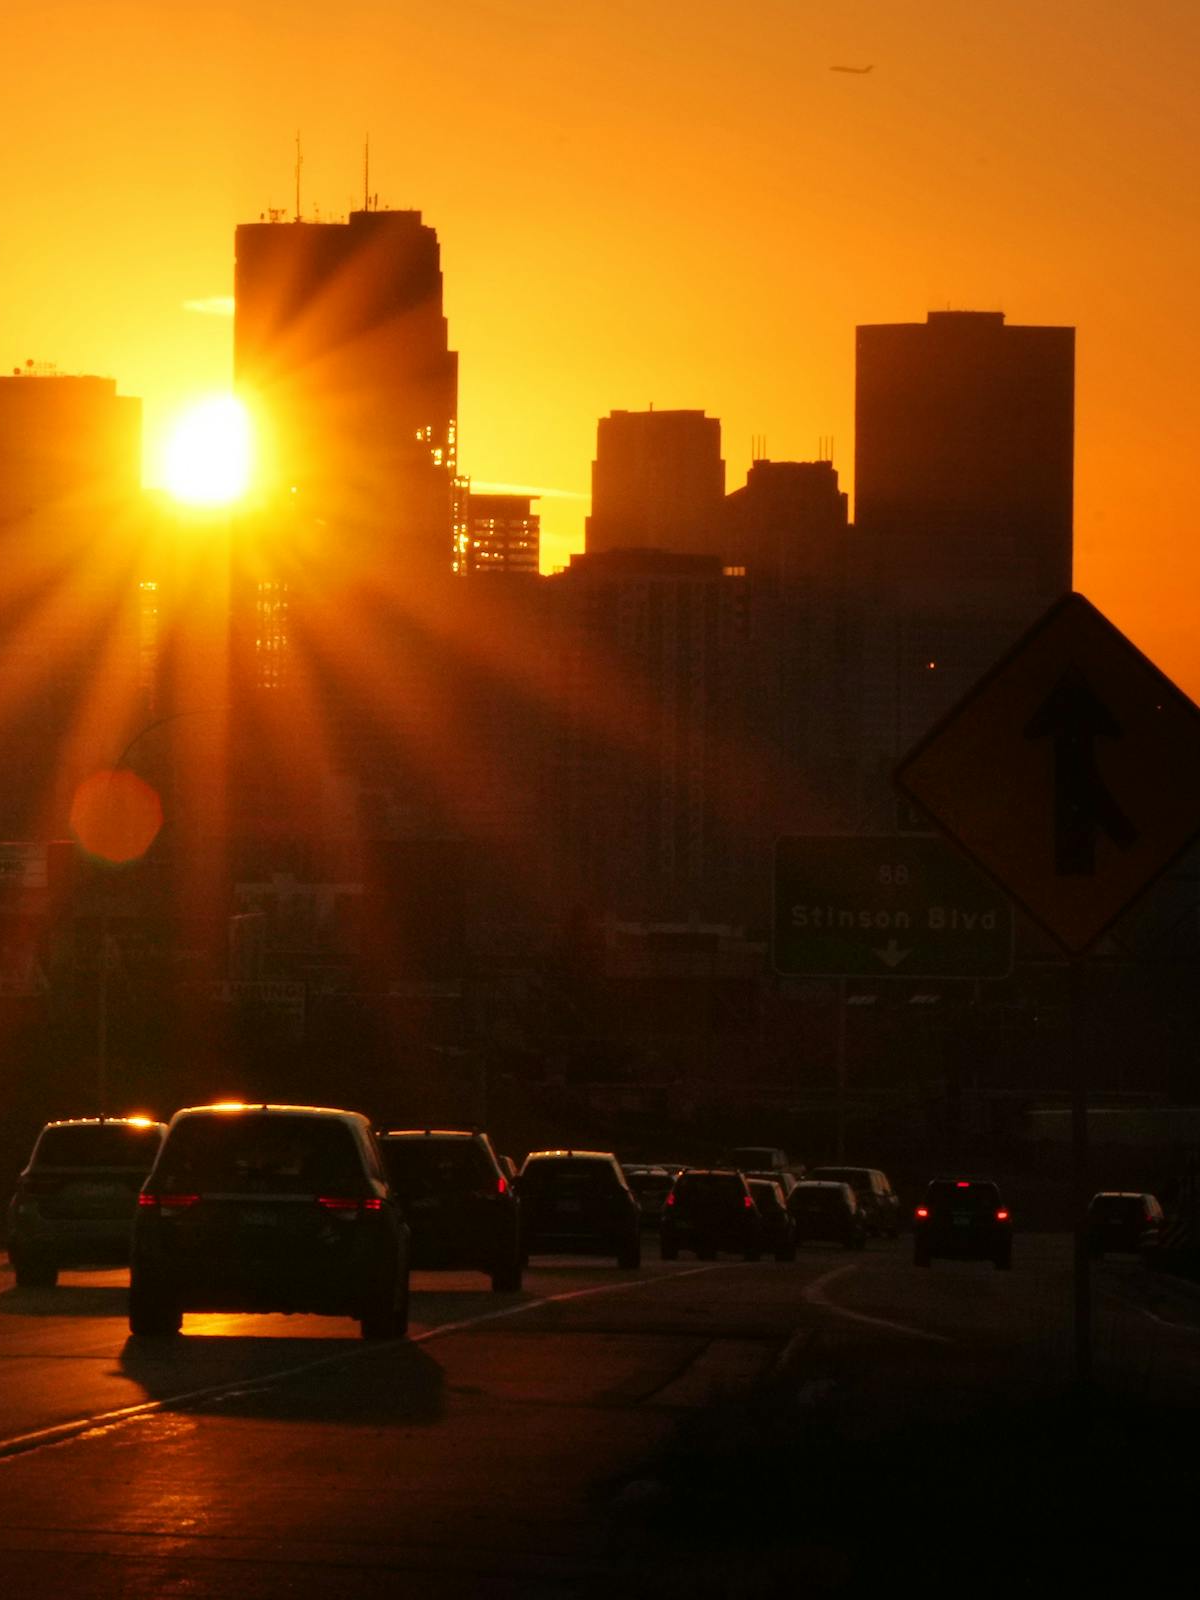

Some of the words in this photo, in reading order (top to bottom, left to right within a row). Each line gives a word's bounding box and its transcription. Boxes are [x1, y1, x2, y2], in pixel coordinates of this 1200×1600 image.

[879, 863, 909, 885] 88
[791, 904, 912, 929] Stinson
[927, 904, 998, 929] Blvd
